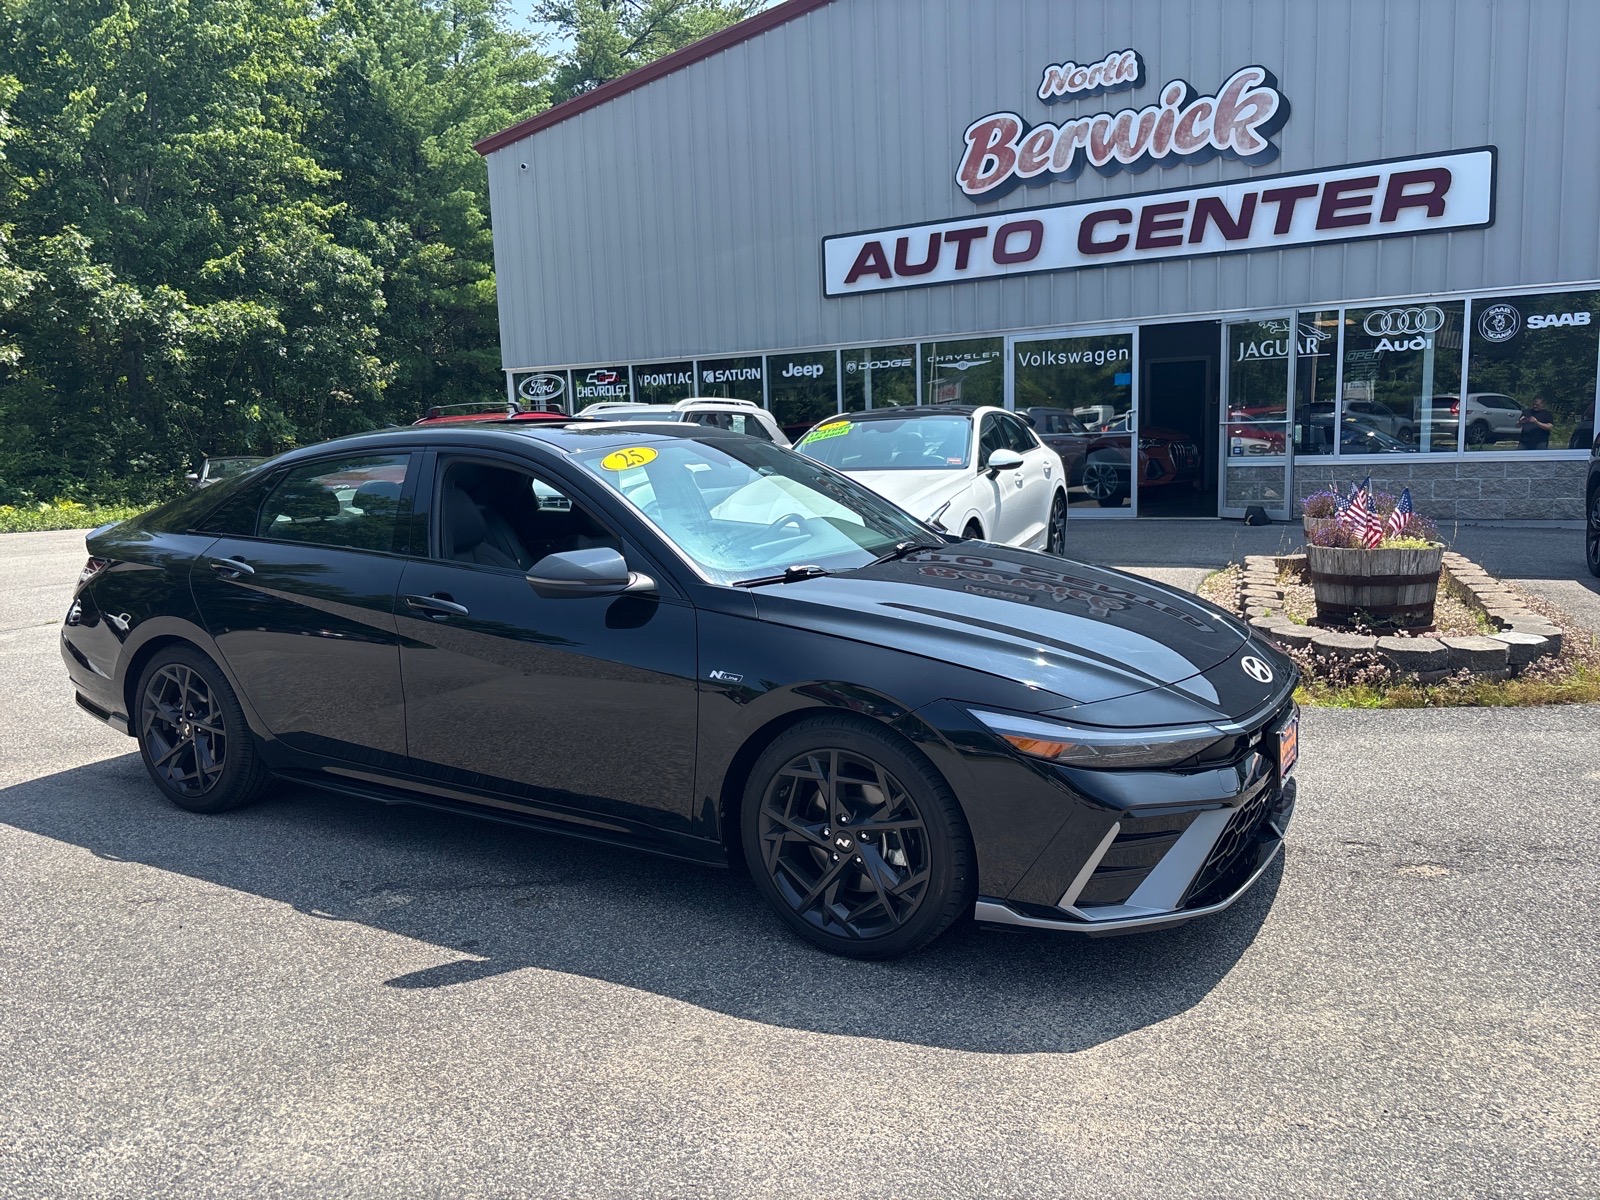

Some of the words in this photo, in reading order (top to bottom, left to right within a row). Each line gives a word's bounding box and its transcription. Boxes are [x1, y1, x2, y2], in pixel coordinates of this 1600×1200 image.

[1040, 51, 1136, 97] North
[957, 66, 1277, 193] Berwick
[843, 219, 1044, 284] AUTO
[1077, 167, 1452, 256] CENTER
[1526, 311, 1591, 329] SAAB
[1374, 336, 1432, 352] Audi
[858, 358, 913, 370] DODGE
[928, 351, 1000, 363] CHRYSLER
[1018, 348, 1129, 366] Volkswagen
[715, 367, 761, 382] SATURN
[782, 362, 824, 378] Jeep
[644, 371, 693, 386] PONTIAC
[528, 379, 555, 395] Ford
[577, 384, 628, 398] CHEVROLET
[614, 449, 645, 468] 25
